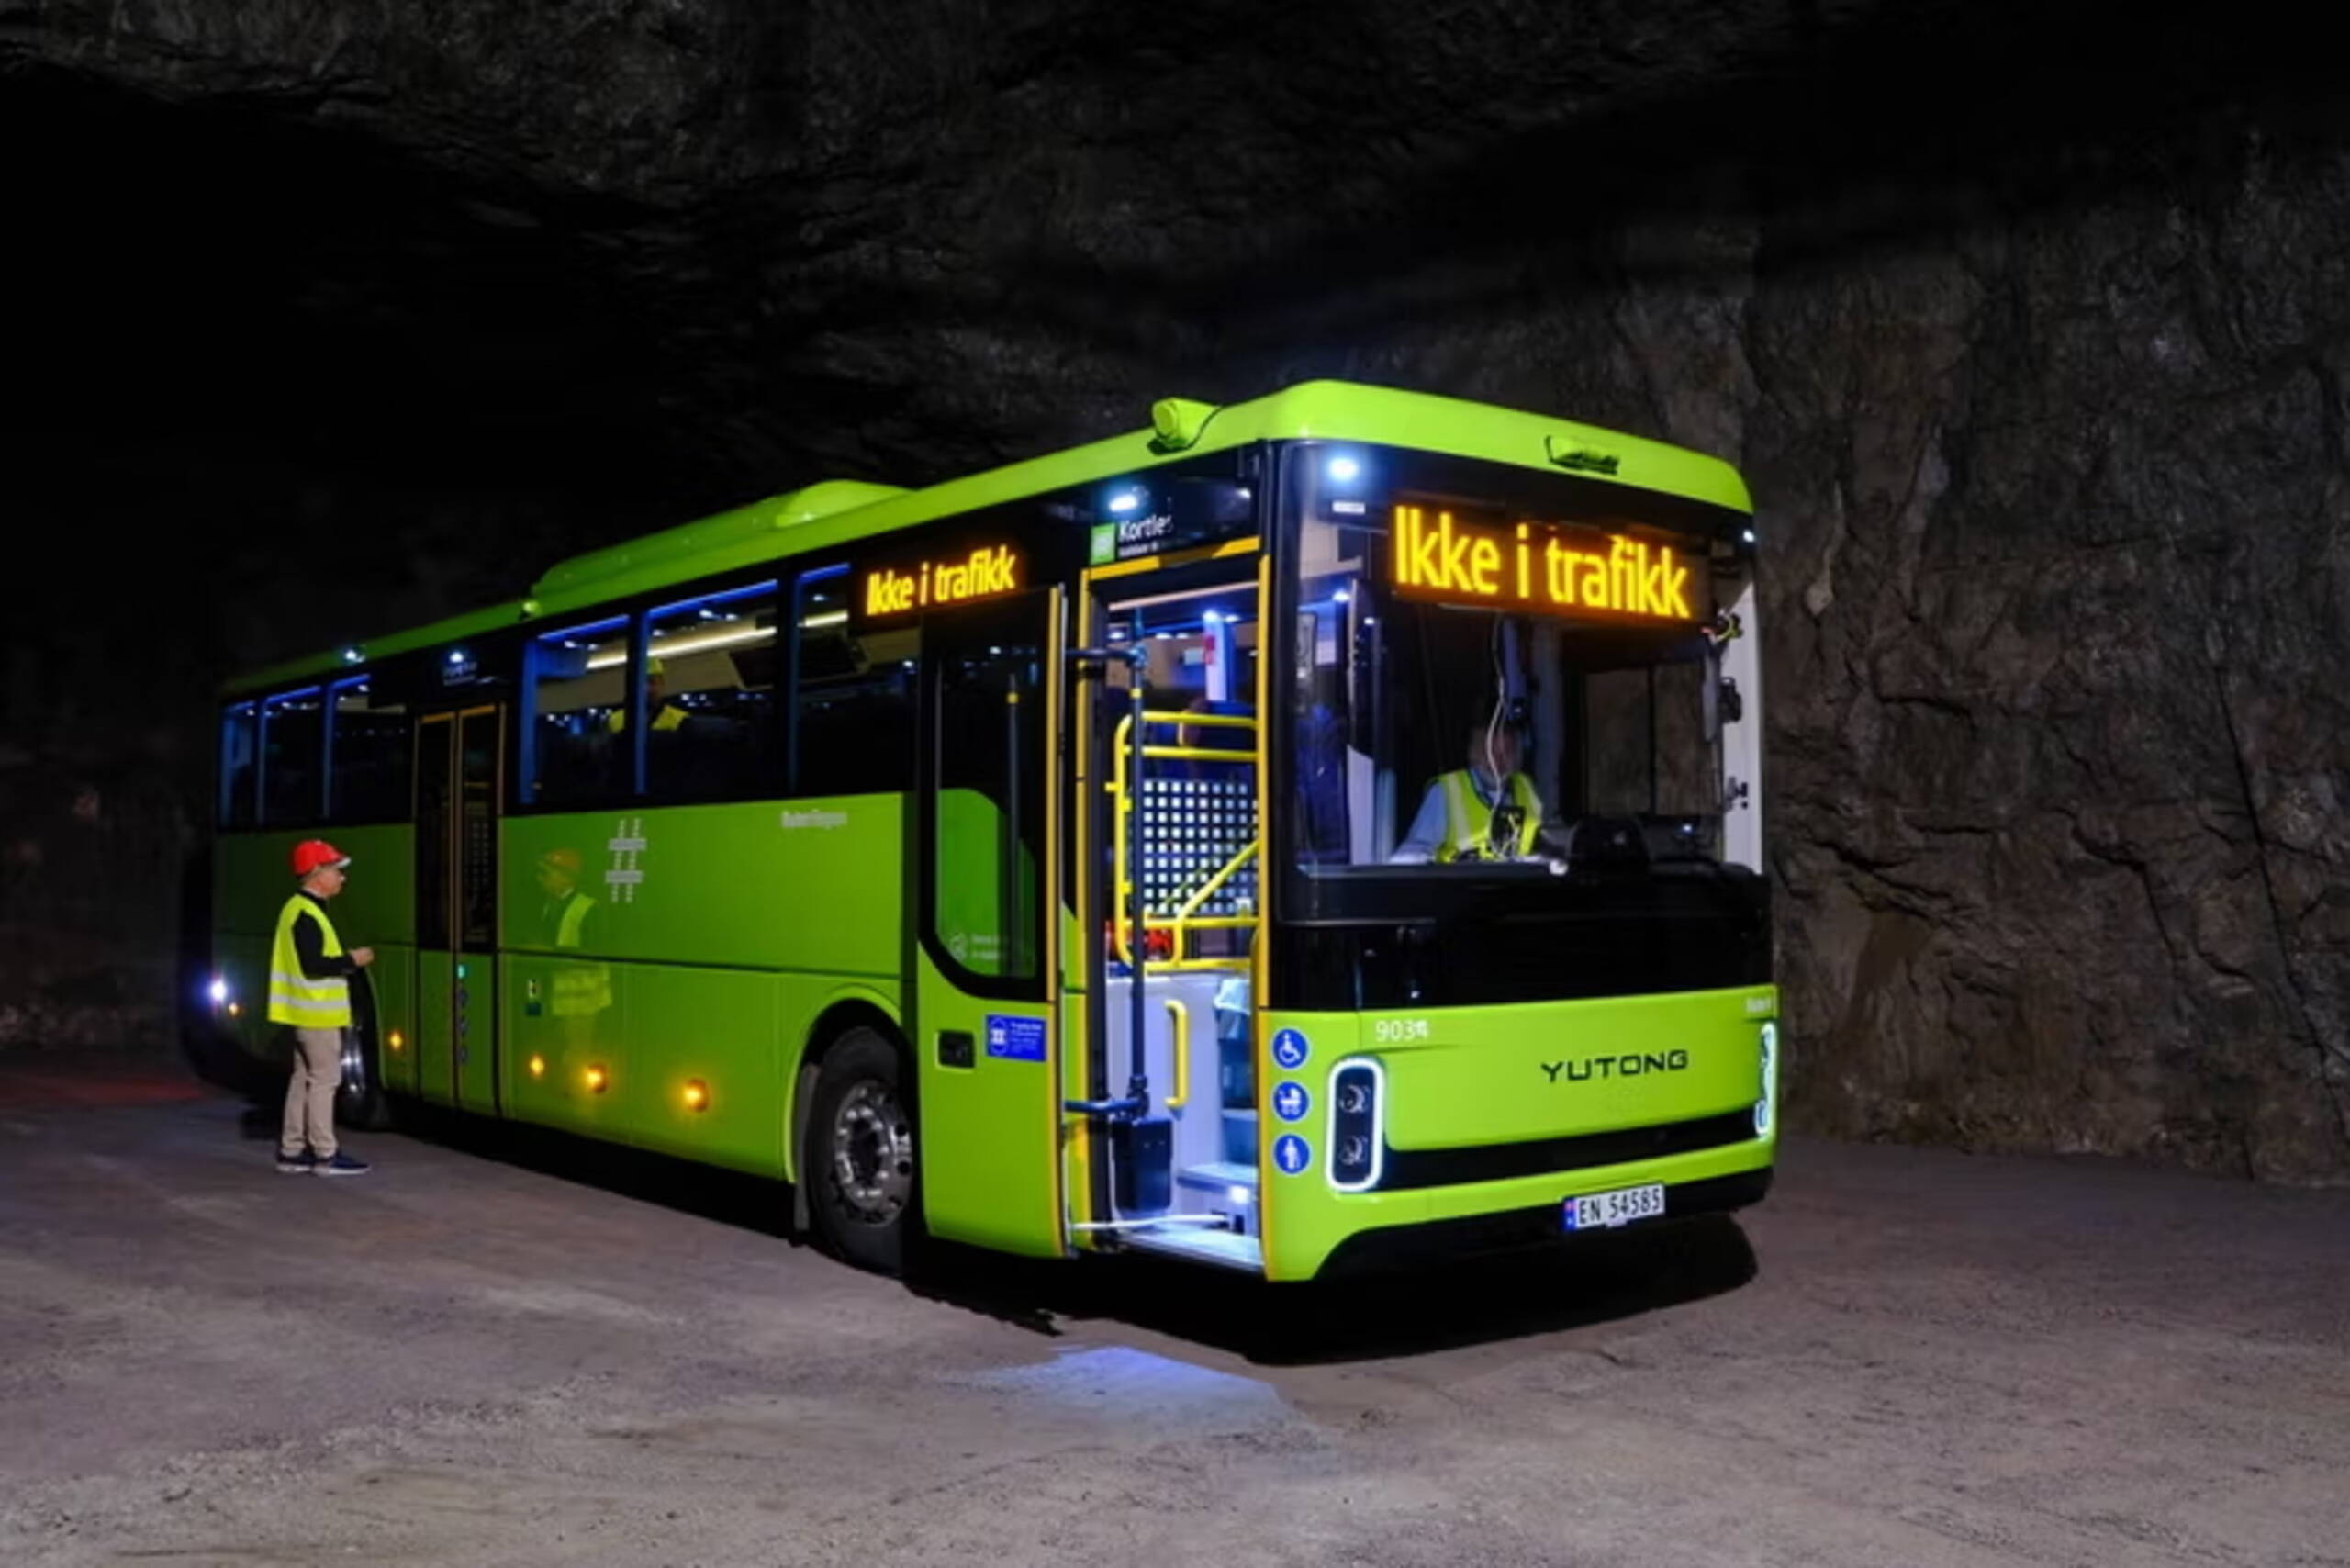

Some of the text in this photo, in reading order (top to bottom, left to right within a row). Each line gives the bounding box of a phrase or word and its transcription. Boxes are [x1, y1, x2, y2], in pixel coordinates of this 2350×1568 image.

[867, 543, 1016, 616] Ikke i trafikk
[1394, 505, 1691, 620] Ikke i trafikk
[1540, 1049, 1689, 1083] YUTONG
[1579, 1187, 1661, 1225] EN 54585
